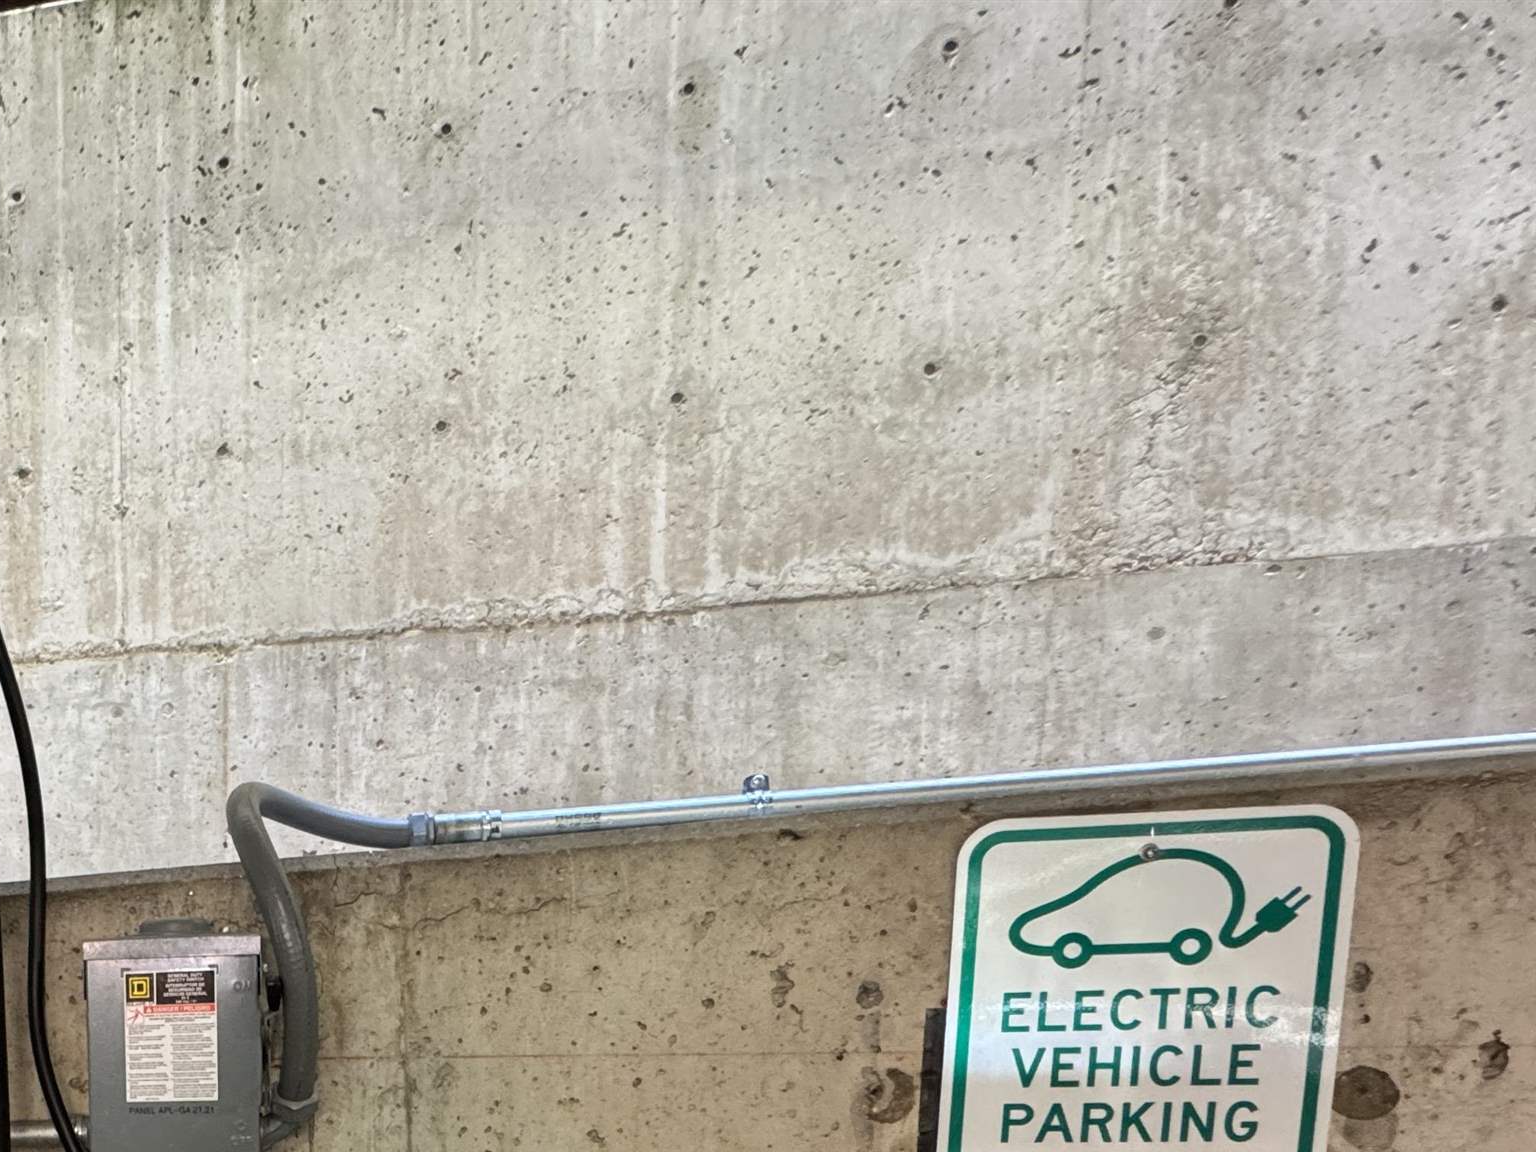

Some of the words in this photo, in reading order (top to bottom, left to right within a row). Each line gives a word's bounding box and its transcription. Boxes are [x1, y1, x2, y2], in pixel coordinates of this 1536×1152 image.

[1001, 985, 1281, 1033] ELECTRIC
[1012, 1043, 1261, 1088] VEHICLE
[1000, 1101, 1259, 1143] PARKING
